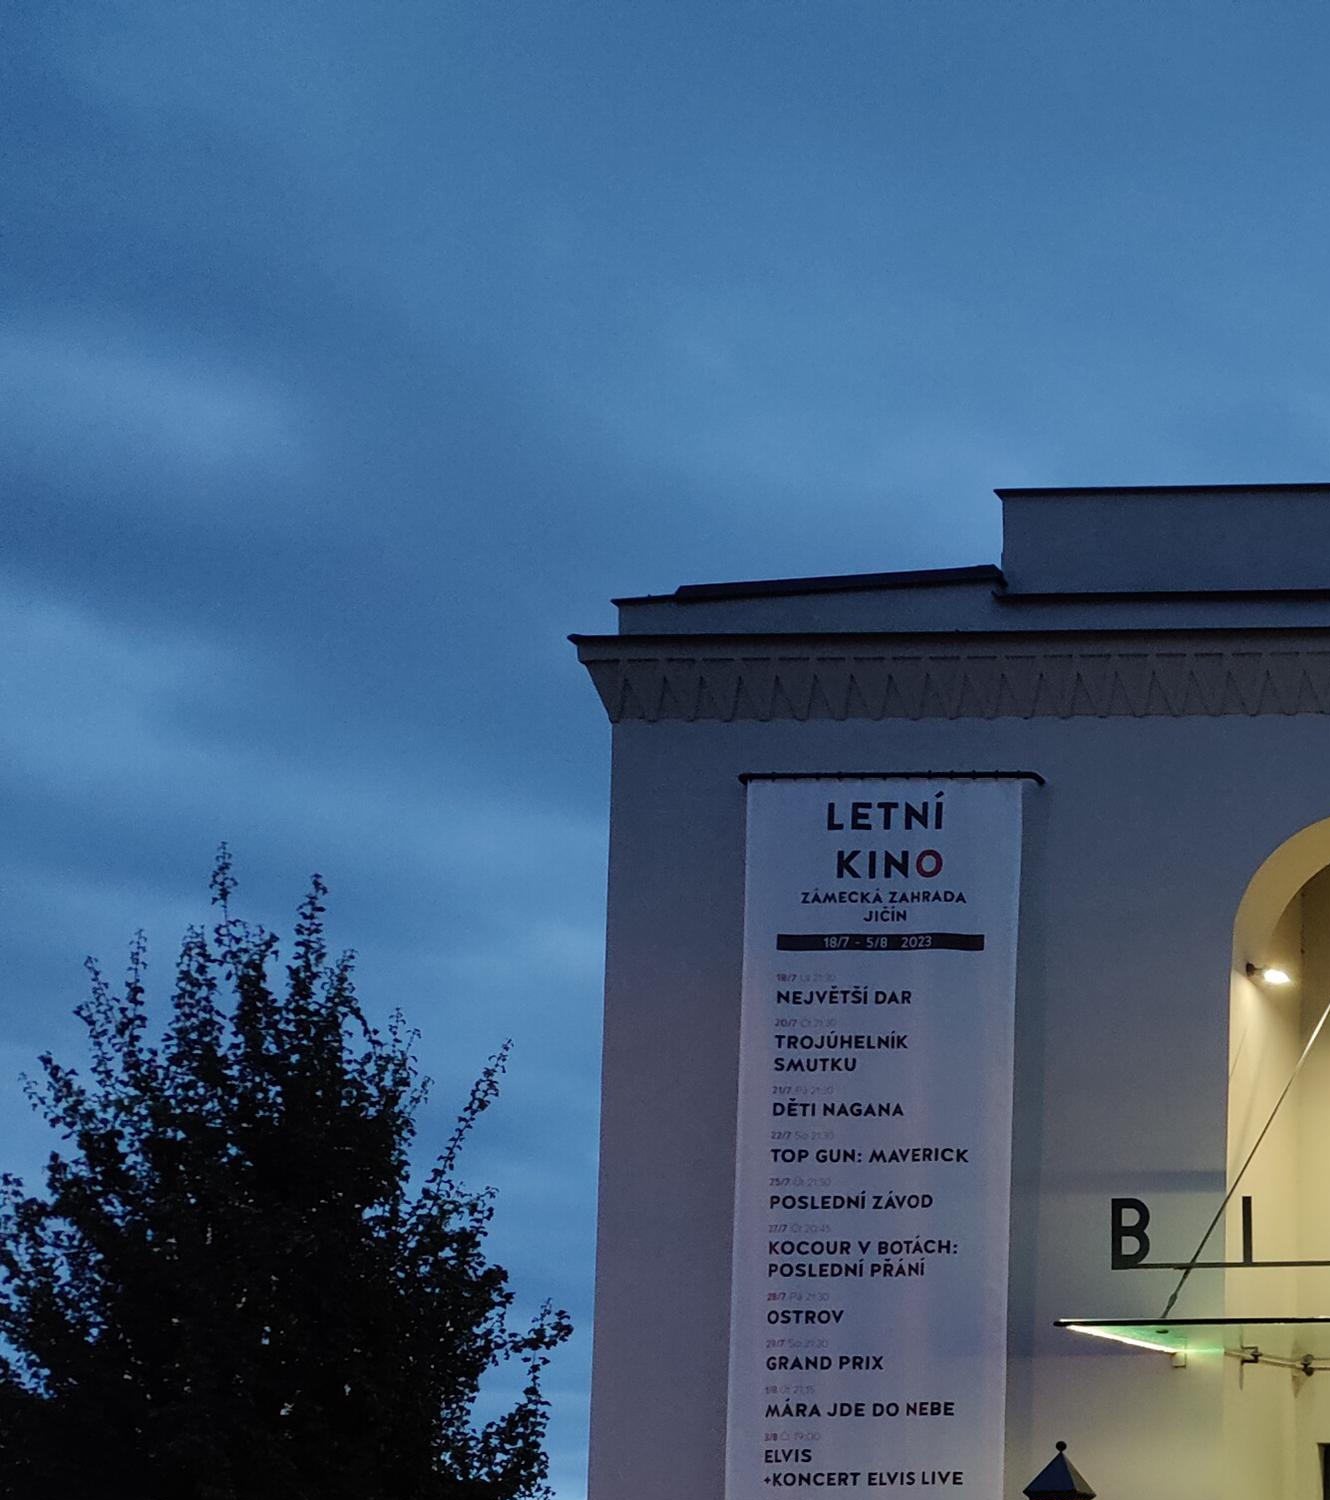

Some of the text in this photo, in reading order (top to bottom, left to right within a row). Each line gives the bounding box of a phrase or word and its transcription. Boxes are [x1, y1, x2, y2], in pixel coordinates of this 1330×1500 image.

[827, 791, 944, 831] LETNÍ
[837, 850, 943, 879] KINO
[801, 888, 967, 904] ZÁMECKÁ ZAHRADA
[863, 906, 907, 922] JIČÍN
[823, 936, 850, 949] 18/7
[866, 936, 888, 949] 5/8
[901, 936, 932, 949] 2023
[776, 986, 912, 1005] NEJVĚTŠÍ DAR
[774, 1031, 908, 1049] TROJÚHELNÍK
[774, 1057, 857, 1072] SMUTKU
[772, 1098, 904, 1117] DĚTI NAGANA
[770, 1148, 969, 1163] TOP GUN: MAVERICK
[769, 1191, 934, 1210] POSLEDNÍ ZÁVOD
[768, 1236, 958, 1256] KOCOUR V BOTÁCH:
[768, 1257, 925, 1278] POSLEDNÍ PŘÁNÍ
[767, 1310, 844, 1325] OSTROV
[766, 1356, 884, 1371] GRAND PRIX
[765, 1398, 955, 1418] MÁRA JDE DO NEBE
[764, 1448, 812, 1464] ELVIS
[764, 1471, 963, 1487] +KONCERT ELVIS LIVE
